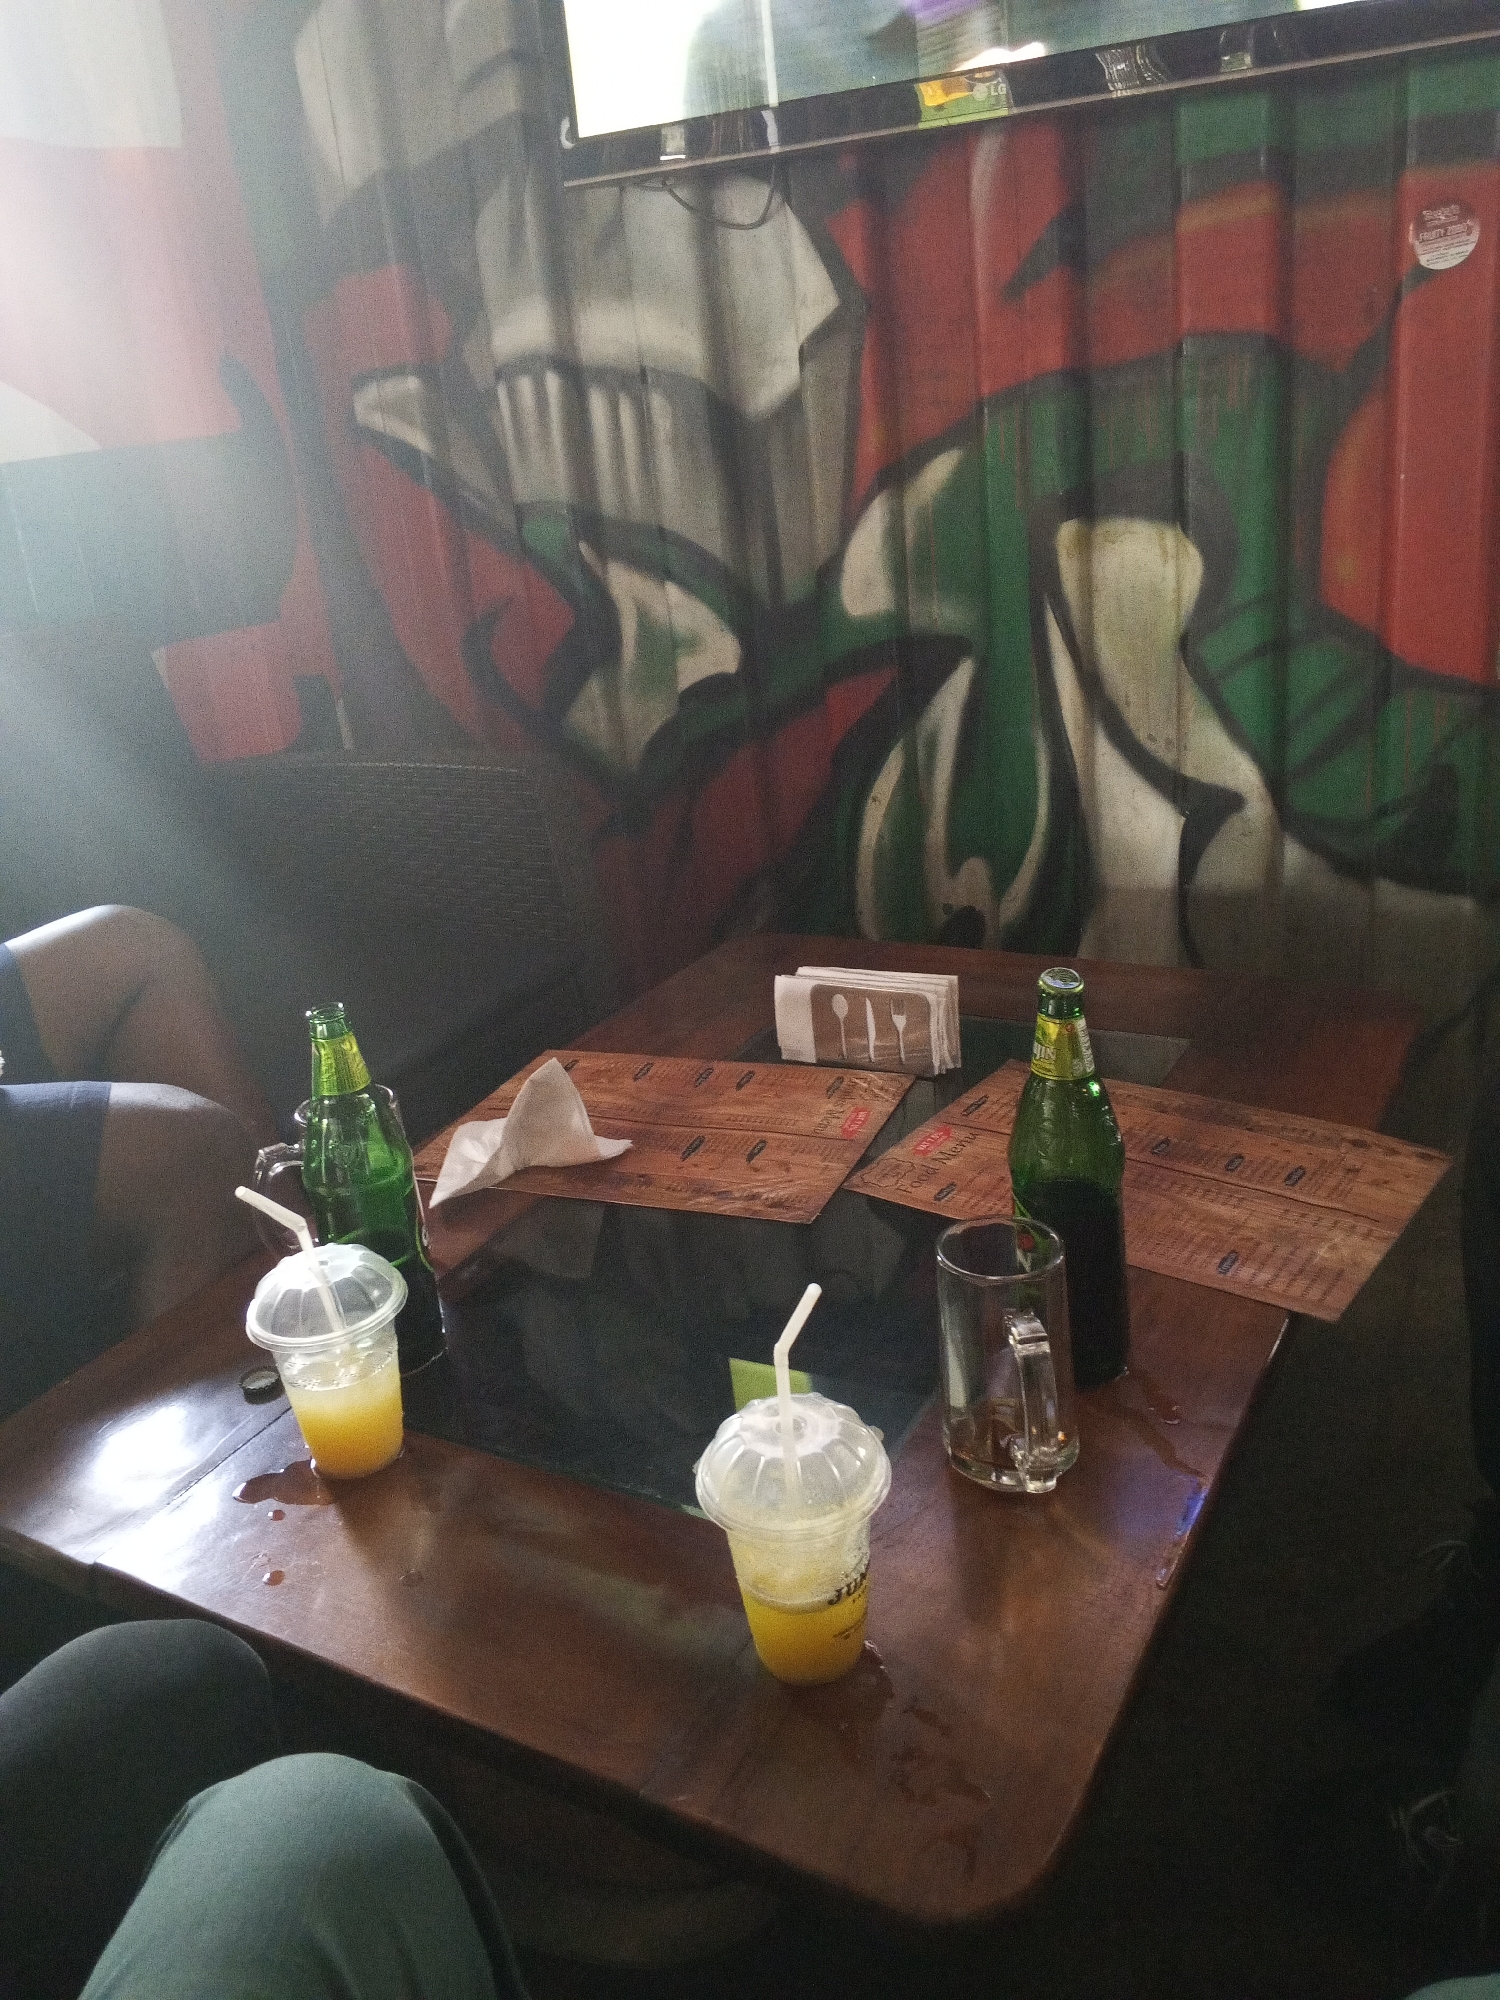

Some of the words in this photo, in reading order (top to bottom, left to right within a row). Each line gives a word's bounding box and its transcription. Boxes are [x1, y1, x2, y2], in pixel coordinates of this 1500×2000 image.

[990, 83, 1007, 96] LG
[896, 1164, 940, 1194] Food
[932, 1132, 979, 1165] Menu
